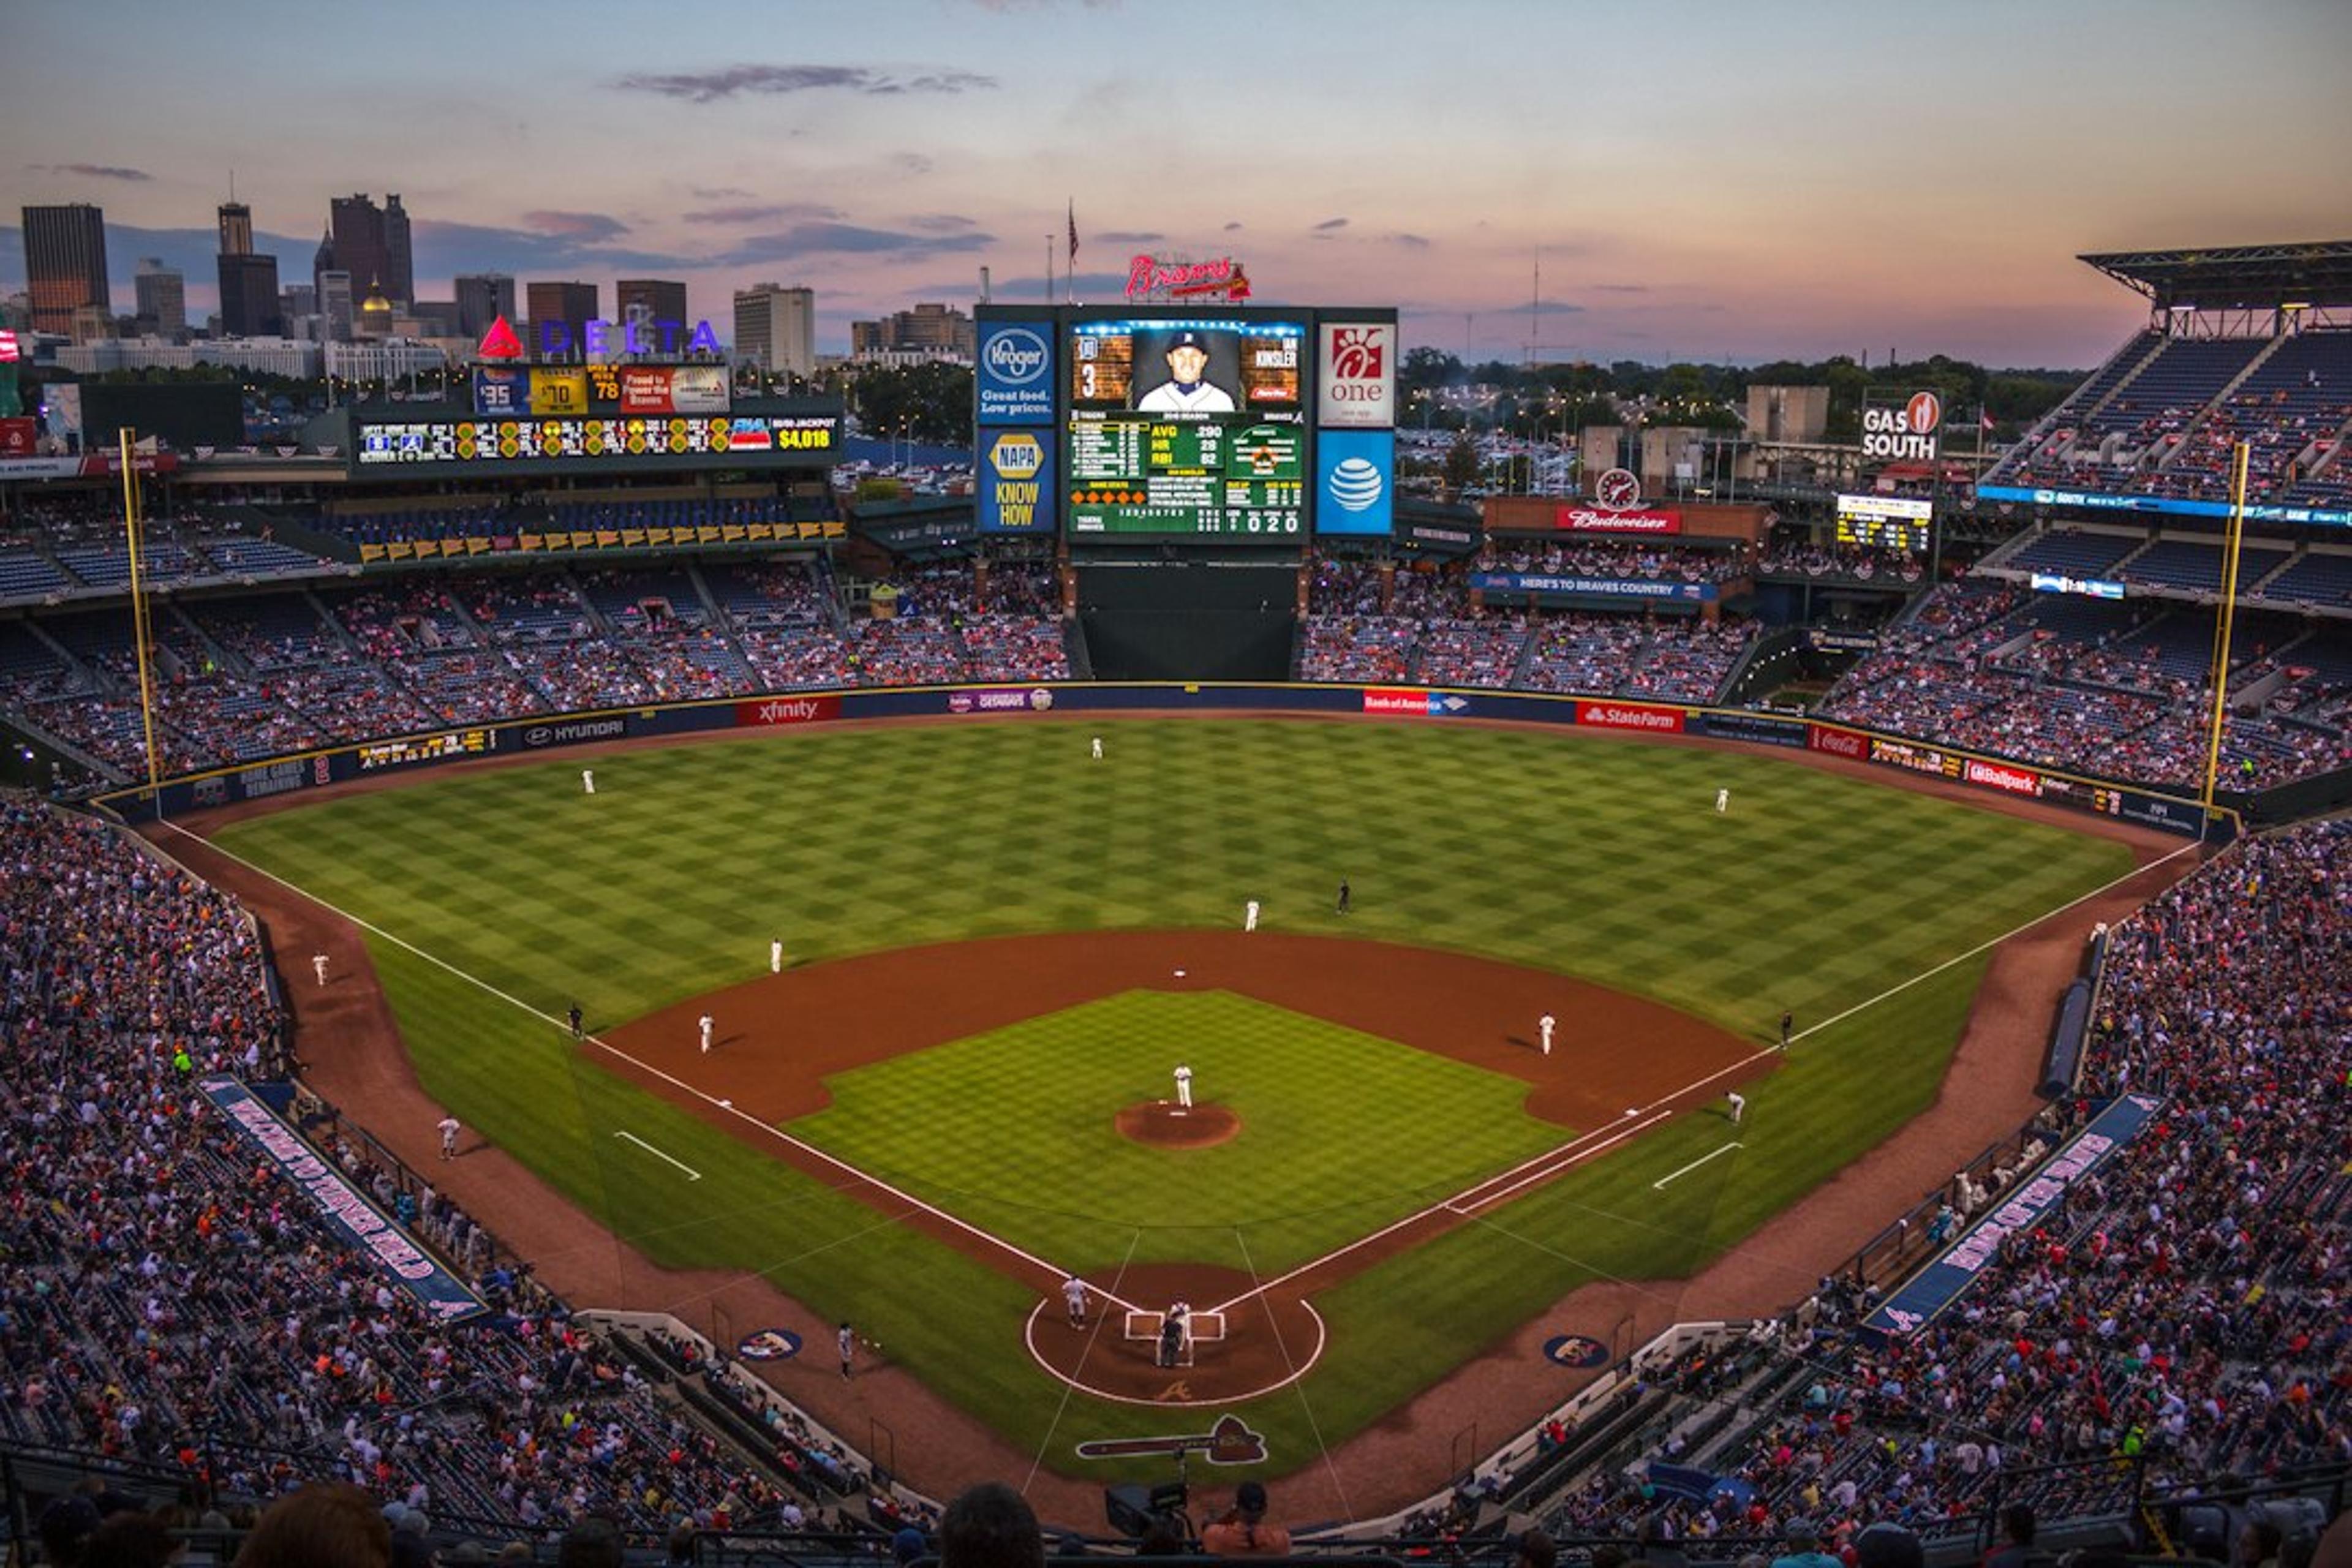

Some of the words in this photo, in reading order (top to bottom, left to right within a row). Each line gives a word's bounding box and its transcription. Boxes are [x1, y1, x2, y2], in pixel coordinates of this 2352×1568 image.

[1126, 255, 1230, 296] Braves
[538, 319, 722, 354] DELTA
[992, 339, 1042, 375] Kroger
[1256, 350, 1297, 367] KINSLER
[627, 374, 654, 385] Proud
[655, 375, 665, 385] to
[1082, 364, 1095, 398] 3
[596, 383, 619, 399] 78
[623, 385, 652, 395] Power
[654, 385, 669, 394] the
[982, 390, 1017, 401] Great
[1019, 390, 1050, 401] food.
[1332, 385, 1382, 401] one
[630, 396, 662, 405] Braves
[981, 402, 1007, 413] Low
[1009, 402, 1052, 416] prices.
[796, 418, 837, 428] JACKPOT
[1864, 410, 1907, 432] GAS
[779, 429, 829, 449] $4,018
[1152, 425, 1177, 438] AVG
[1152, 439, 1170, 451] HR
[1863, 434, 1936, 460] SOUTH
[999, 446, 1035, 467] NAPA
[1152, 453, 1172, 464] RBI
[996, 482, 1039, 504] KNOW
[1000, 505, 1034, 526] HOW
[1568, 511, 1667, 527] Budweiser
[1248, 517, 1261, 532] 0
[1267, 517, 1279, 532] 2
[1285, 517, 1297, 532] 0
[1520, 579, 1559, 589] HERE'S
[1561, 581, 1575, 590] TO
[1576, 581, 1619, 593] BRAVES
[1620, 584, 1674, 595] COUNTRY
[1365, 696, 1390, 707] Bank
[1391, 698, 1401, 708] of
[1402, 698, 1441, 710] America
[760, 700, 818, 723] xfinity
[555, 720, 624, 741] HYUNDAI
[1986, 768, 2034, 791] Ballpark
[363, 1227, 435, 1280] FIELD
